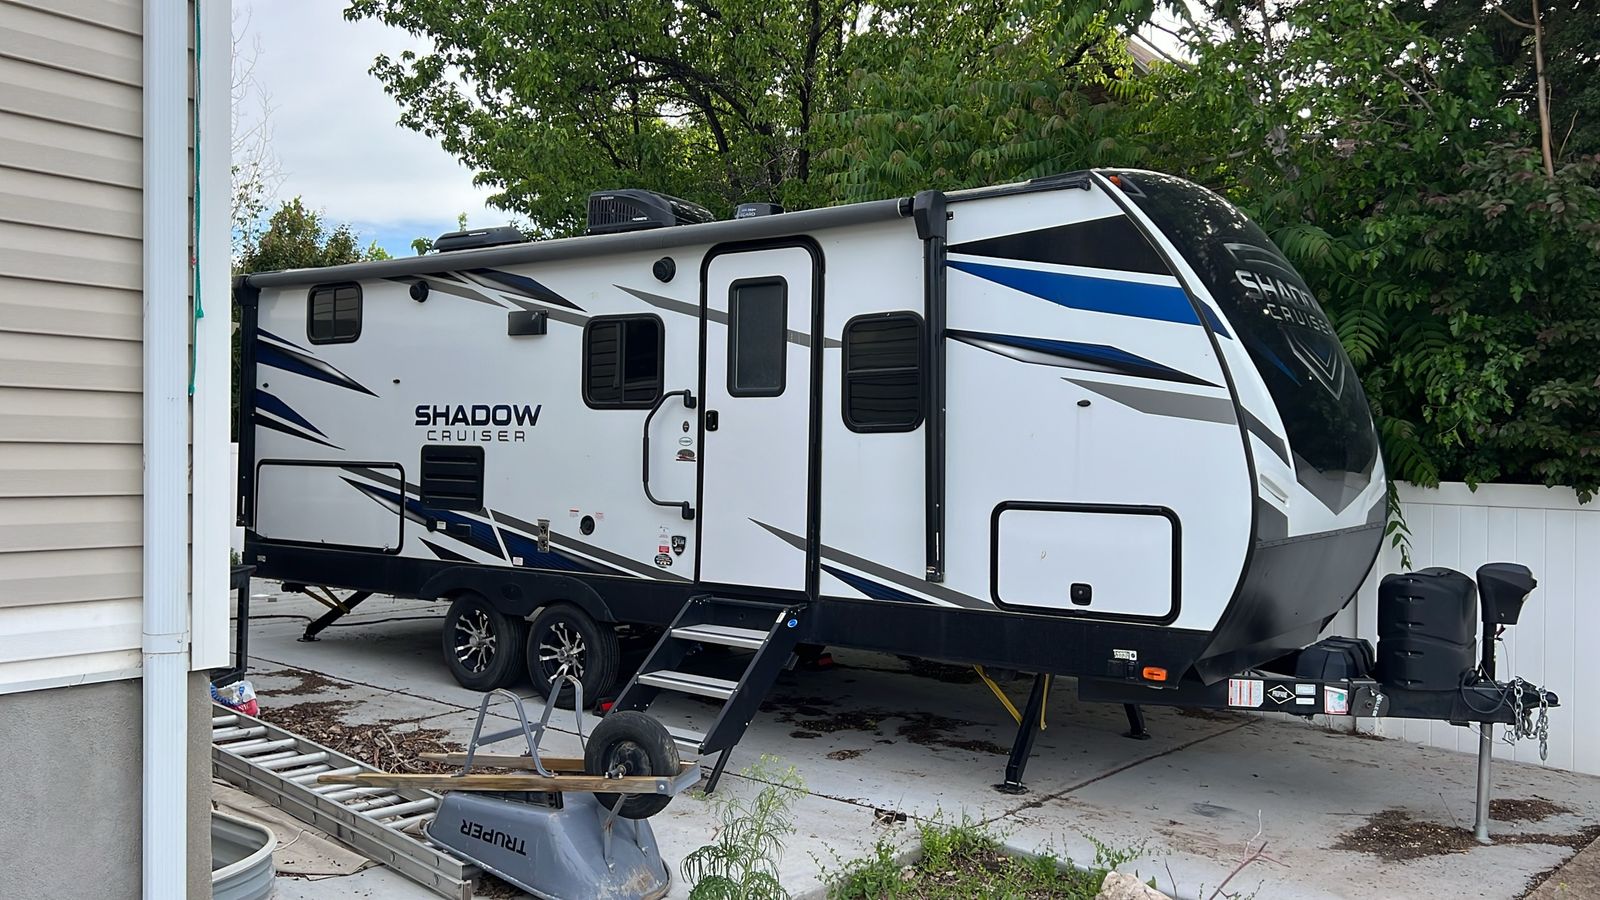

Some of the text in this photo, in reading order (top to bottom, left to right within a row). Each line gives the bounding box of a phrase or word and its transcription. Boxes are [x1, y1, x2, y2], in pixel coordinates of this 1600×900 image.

[1235, 269, 1318, 312] SHADO
[415, 405, 542, 426] SHADOW
[427, 430, 525, 442] CRUISER
[460, 819, 526, 856] TRUPER
